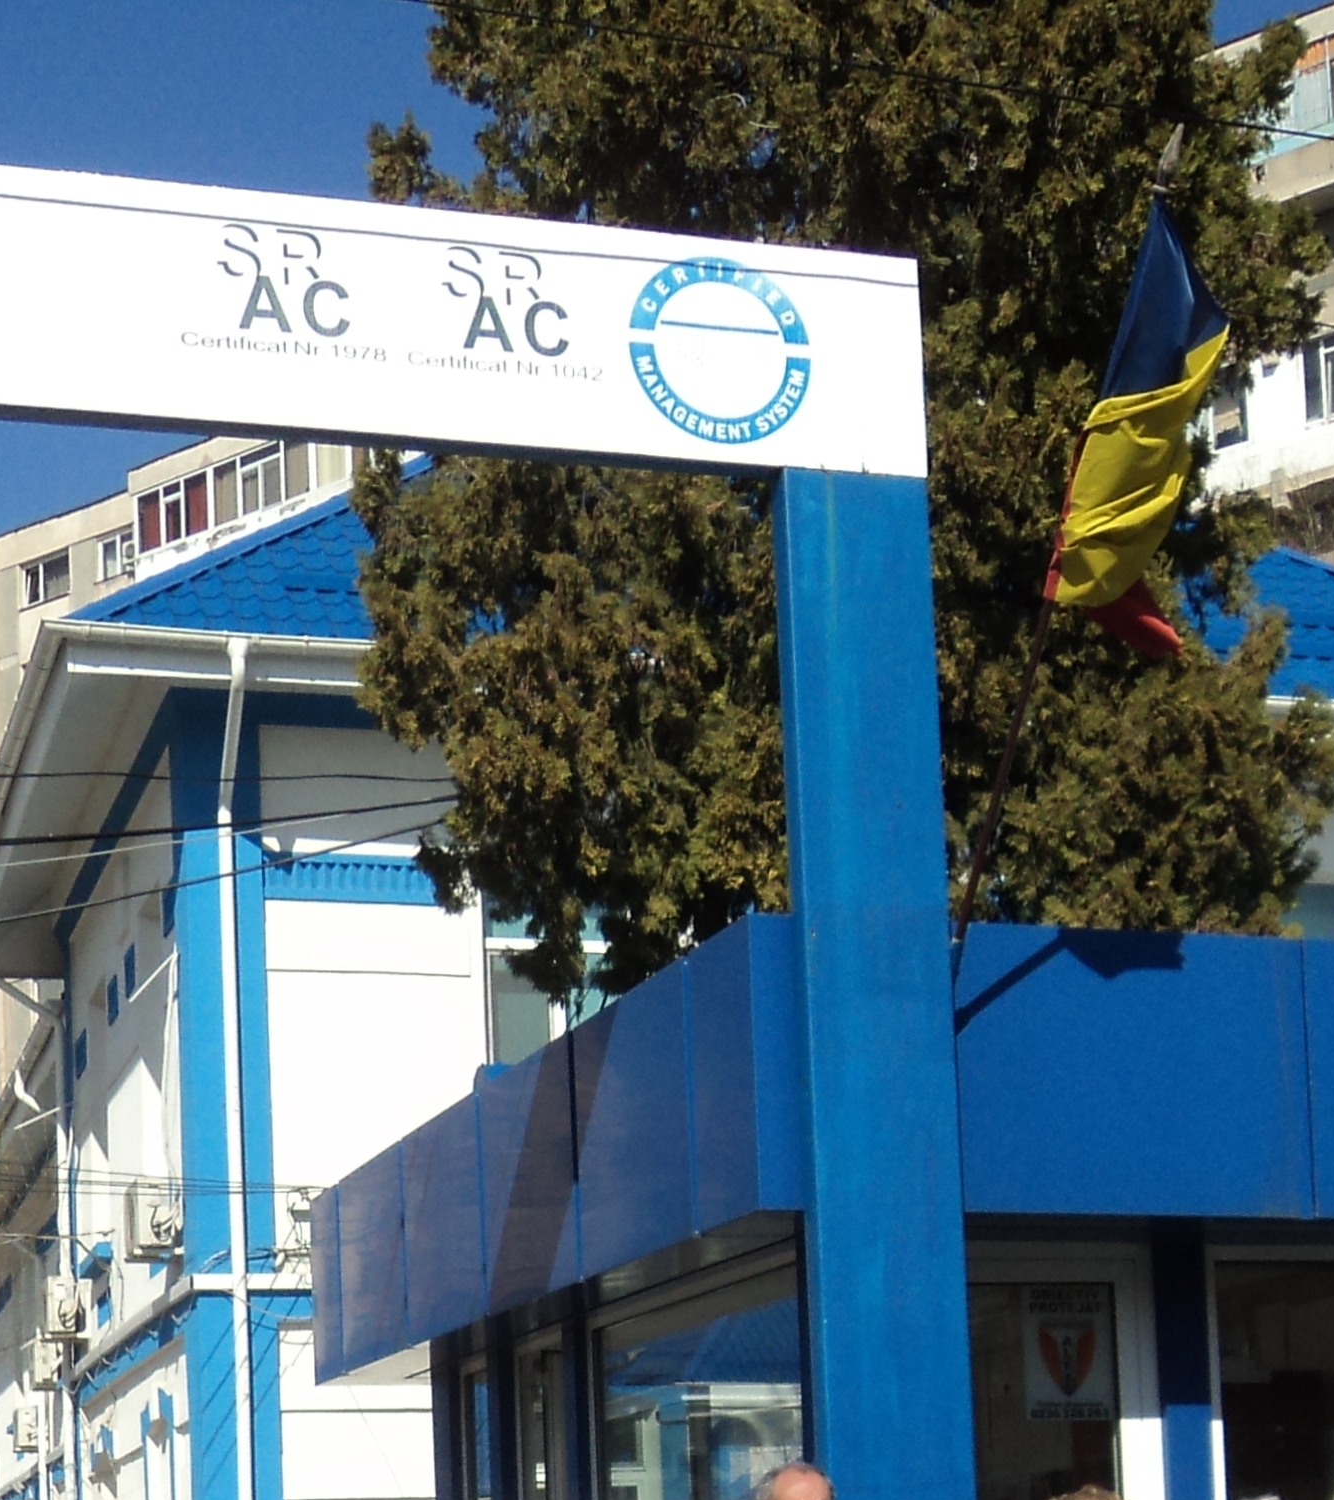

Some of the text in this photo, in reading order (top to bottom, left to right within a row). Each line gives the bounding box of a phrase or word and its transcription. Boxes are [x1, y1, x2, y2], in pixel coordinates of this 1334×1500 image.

[180, 330, 287, 354] Certificat
[407, 350, 508, 374] Certificat
[636, 354, 806, 440] MANAGEMENT SYSTEM
